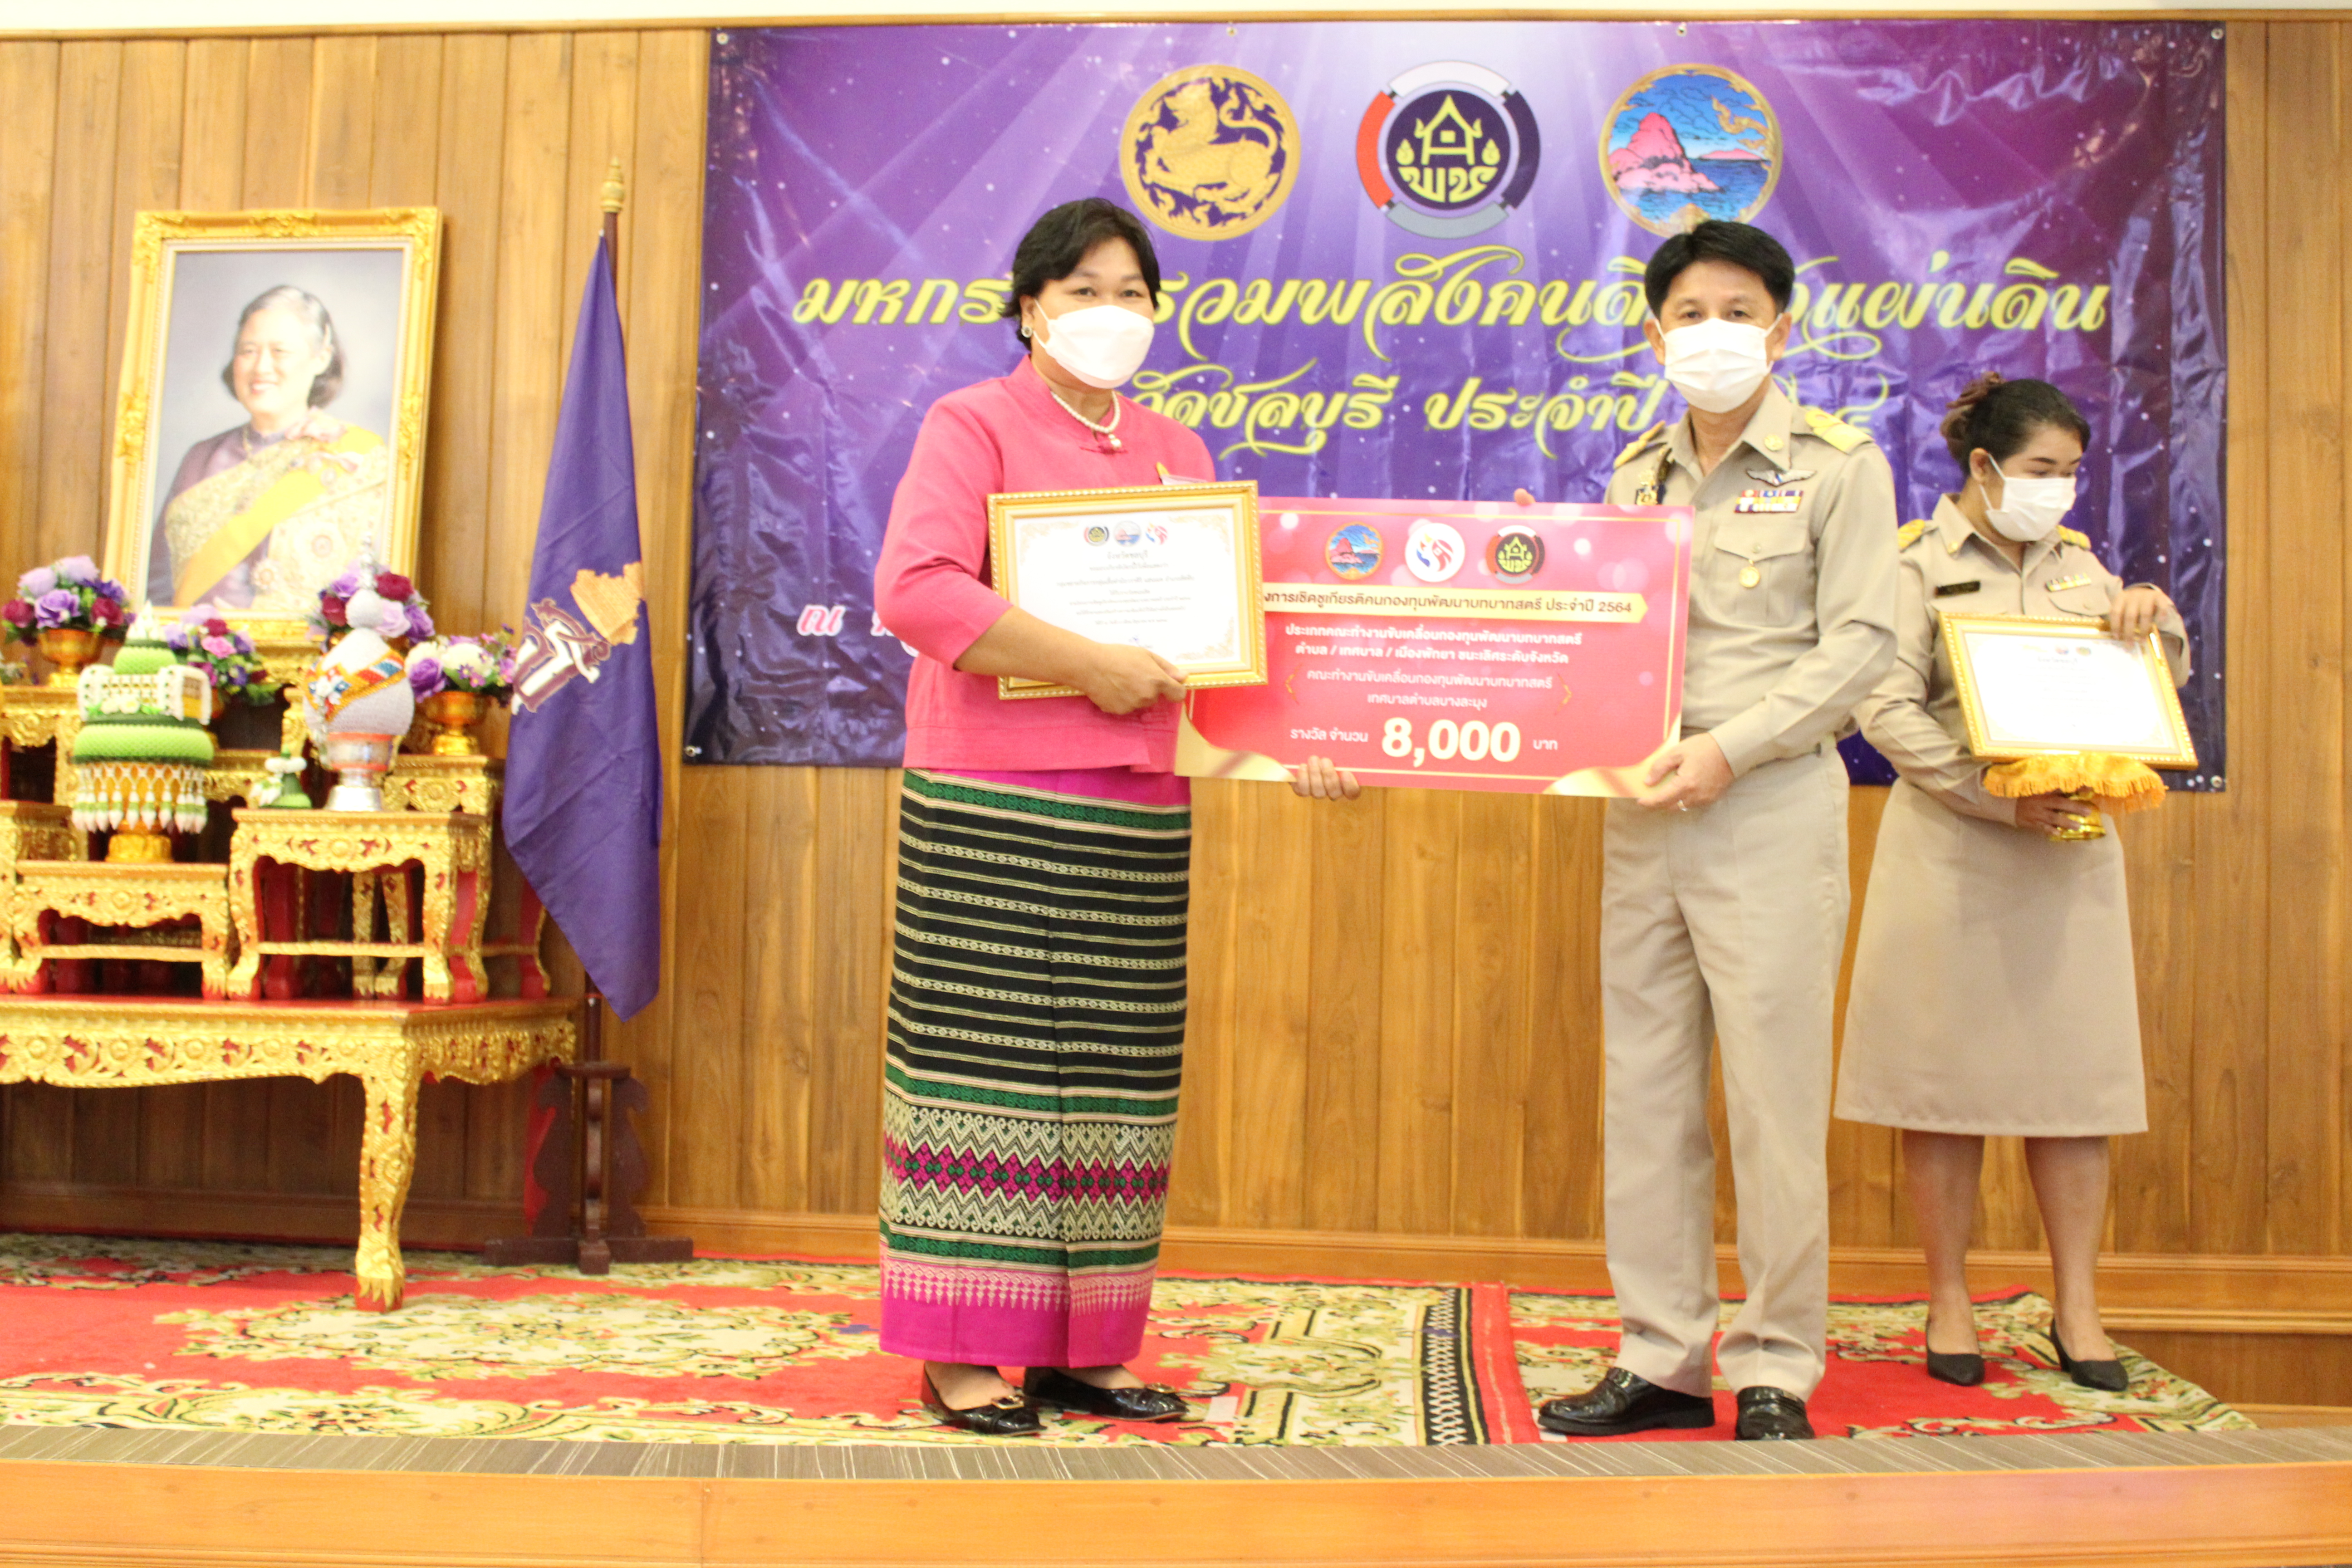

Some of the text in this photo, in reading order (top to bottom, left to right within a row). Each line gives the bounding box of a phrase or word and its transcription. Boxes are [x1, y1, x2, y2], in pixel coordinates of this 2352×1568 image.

[1424, 372, 1669, 459] ประจำปี
[1264, 591, 1632, 613] งการเชิดชูเกียรติคนกองทุนพัฒนาบทบาทสตรี ประจำปี 2564
[1295, 642, 1569, 664] ตำบล / เทศบาล / เมืองพัทยา ชนะเลิศระดับจังหวัด
[1307, 667, 1553, 689] คณะทำงานขับเคลื่อนกองทุนพัฒนาบทบาทสตรี
[1367, 692, 1488, 710] เทศบาลตำบลบางละมุง
[1290, 717, 1558, 767] รางวัล จำนวน 8,000 บาท
